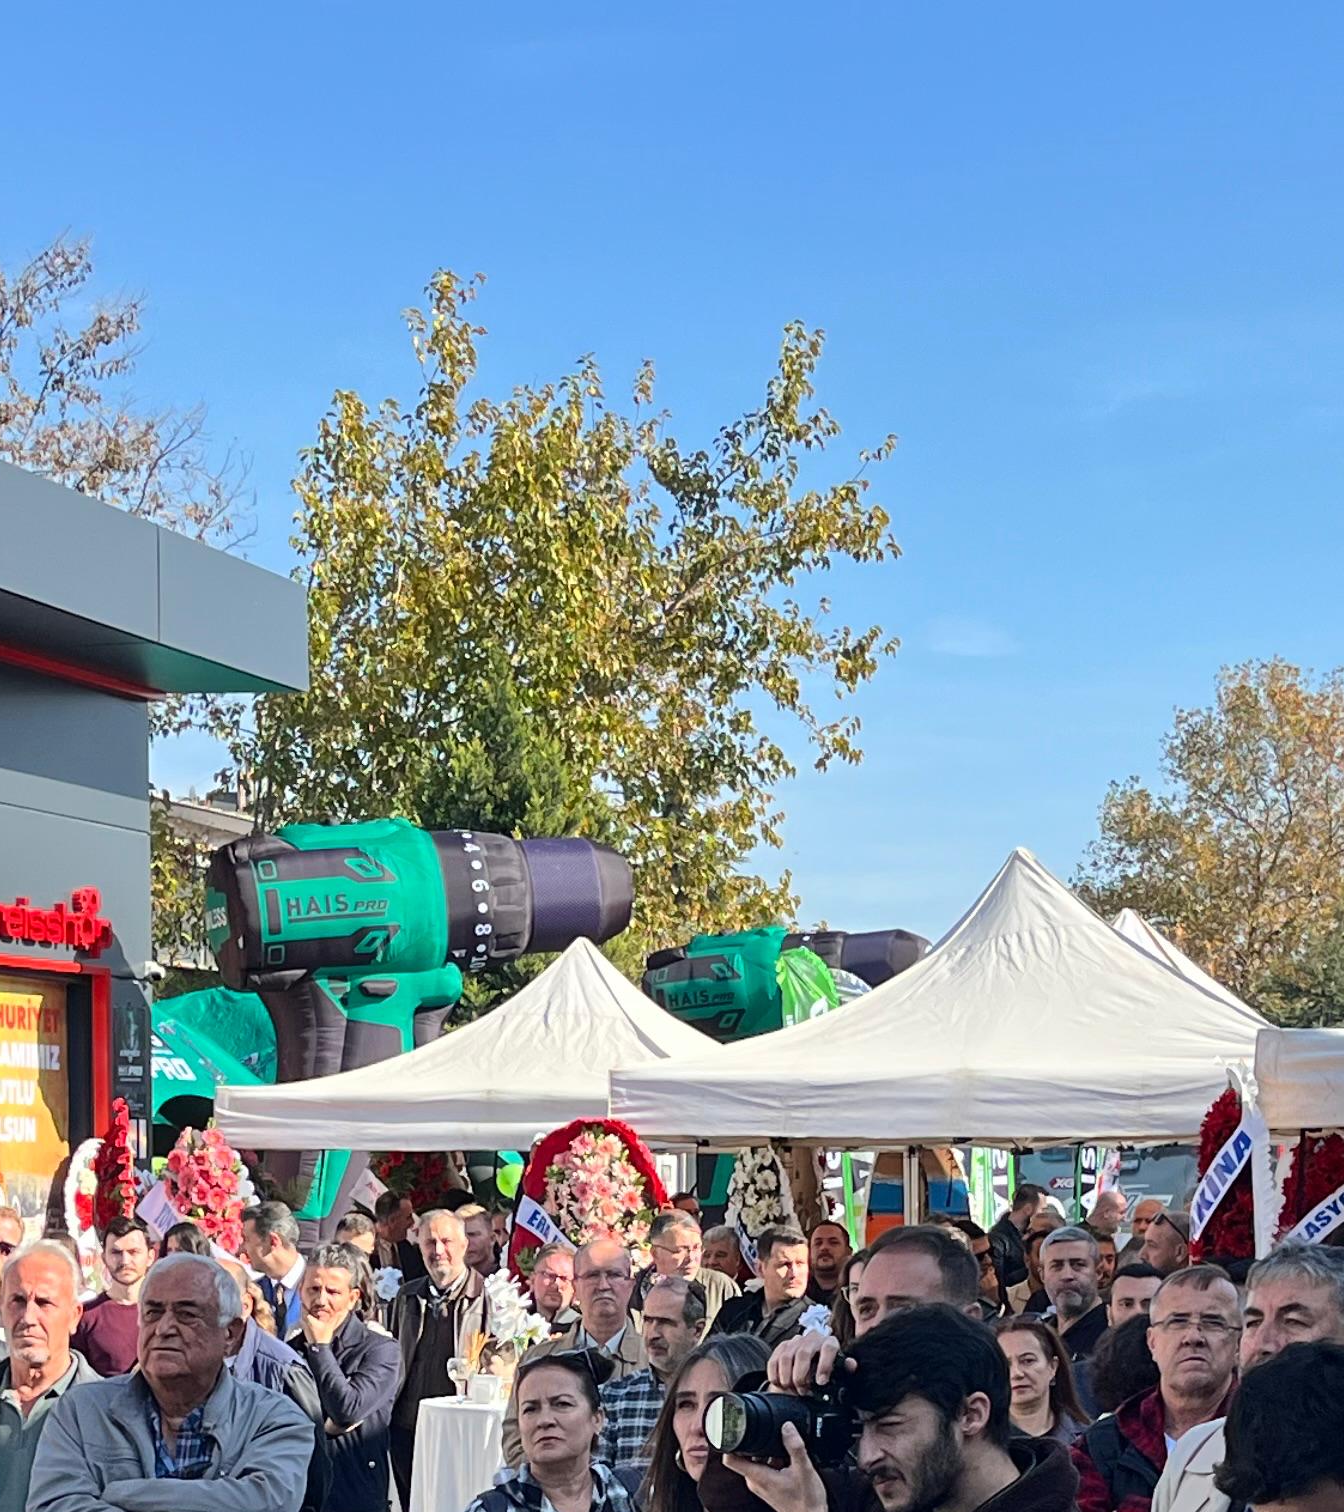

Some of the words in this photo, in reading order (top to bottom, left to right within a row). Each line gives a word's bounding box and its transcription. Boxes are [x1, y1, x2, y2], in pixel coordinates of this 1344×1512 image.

[287, 893, 349, 915] HAIS
[668, 989, 710, 1009] HAIS
[1190, 1130, 1252, 1230] KİNA
